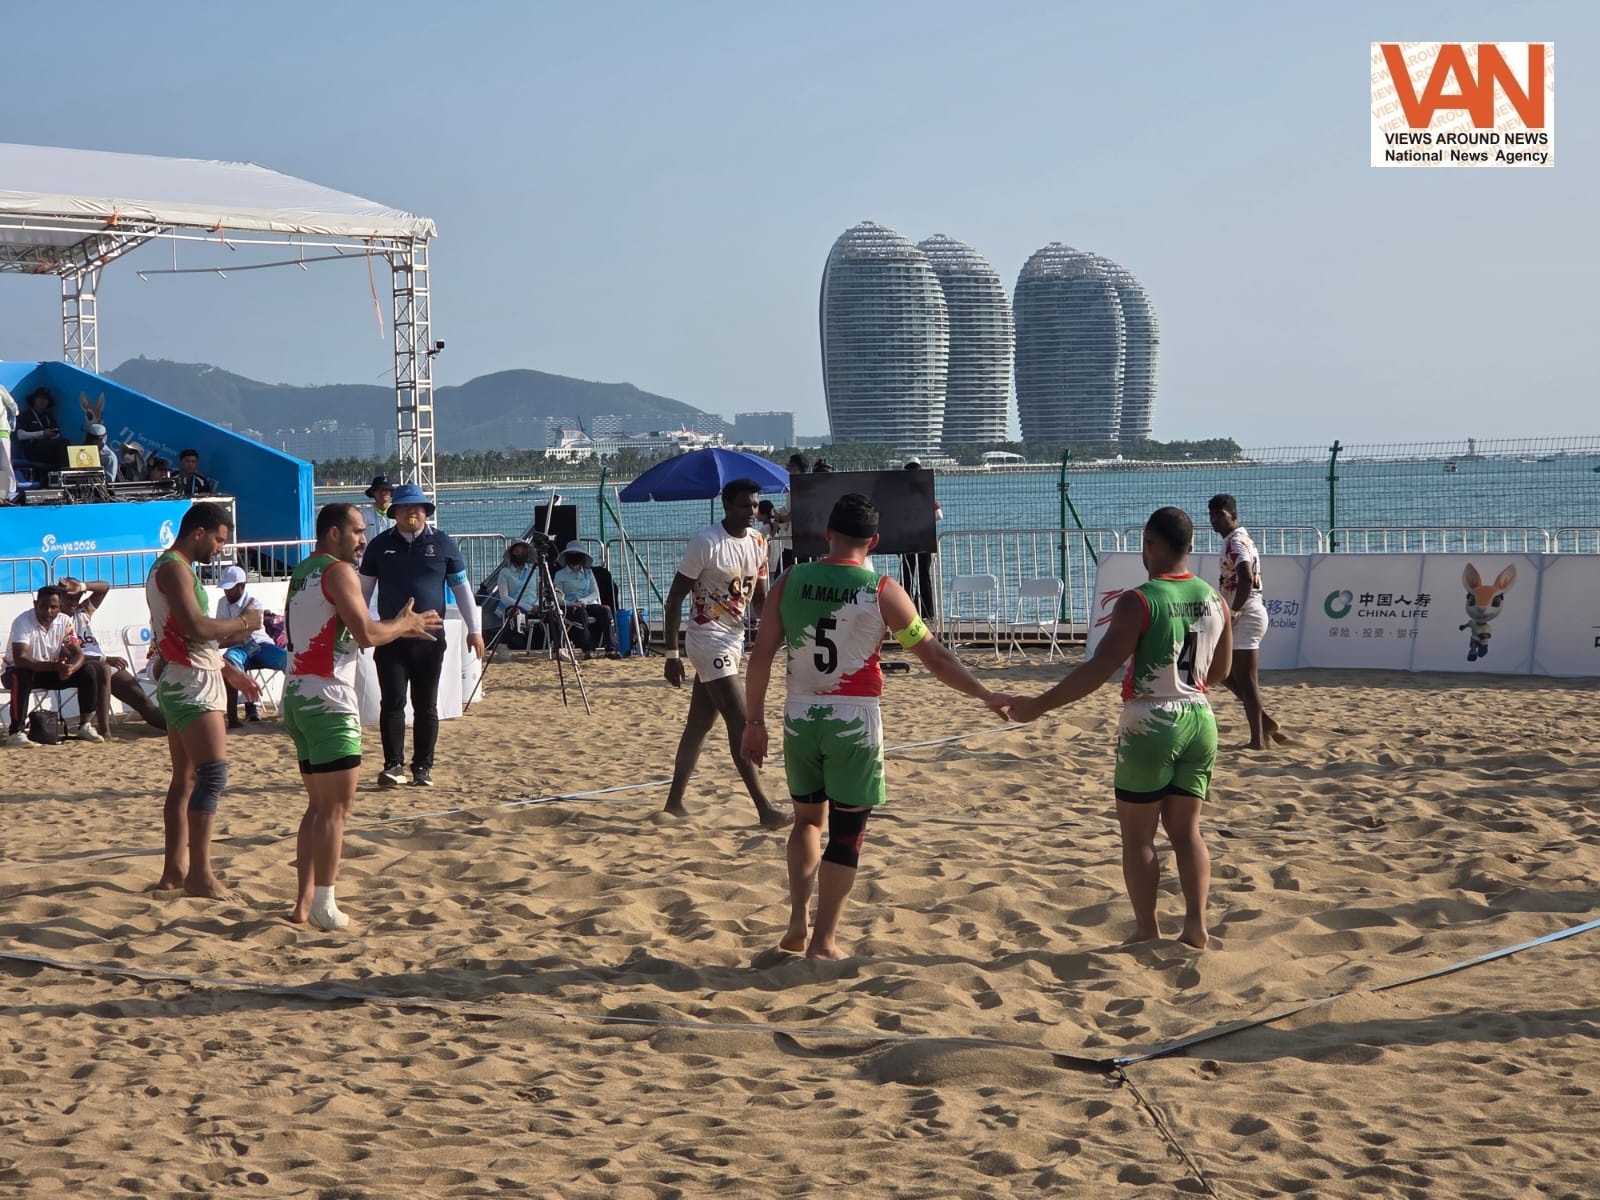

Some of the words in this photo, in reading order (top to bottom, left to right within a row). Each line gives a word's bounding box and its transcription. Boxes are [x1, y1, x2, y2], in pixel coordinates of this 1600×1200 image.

[728, 576, 754, 598] 05
[802, 584, 860, 605] M.MALAK
[1263, 600, 1300, 616] 移动
[1360, 593, 1431, 608] 中国人寿
[1358, 609, 1397, 618] CHINA
[1401, 609, 1429, 618] LIFE
[814, 617, 838, 675] 5
[713, 656, 732, 670] 05
[1177, 632, 1198, 685] 4
